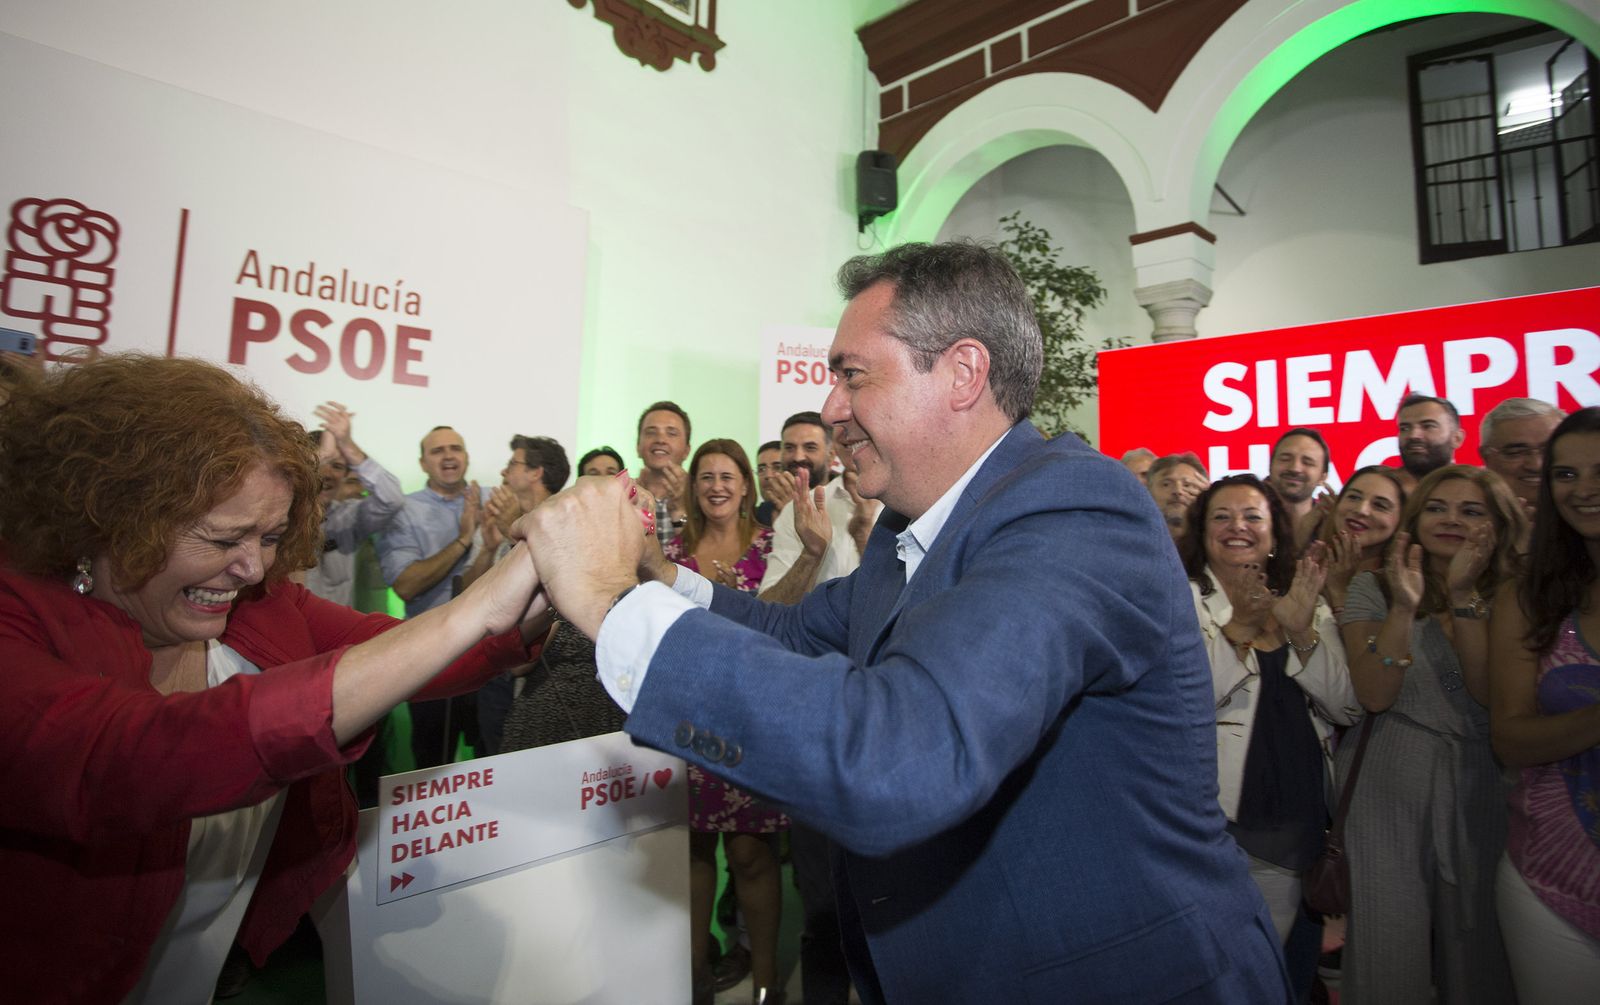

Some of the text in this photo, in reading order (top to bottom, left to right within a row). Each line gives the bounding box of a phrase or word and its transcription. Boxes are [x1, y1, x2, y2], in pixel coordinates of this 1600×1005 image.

[236, 249, 422, 316] Andalucía
[228, 297, 432, 388] PSOE
[391, 768, 494, 806] SIEMPRE
[581, 763, 633, 785] Andalucía
[581, 776, 637, 810] PSOE
[391, 800, 472, 835] HACIA
[391, 820, 499, 864] DELANTE
